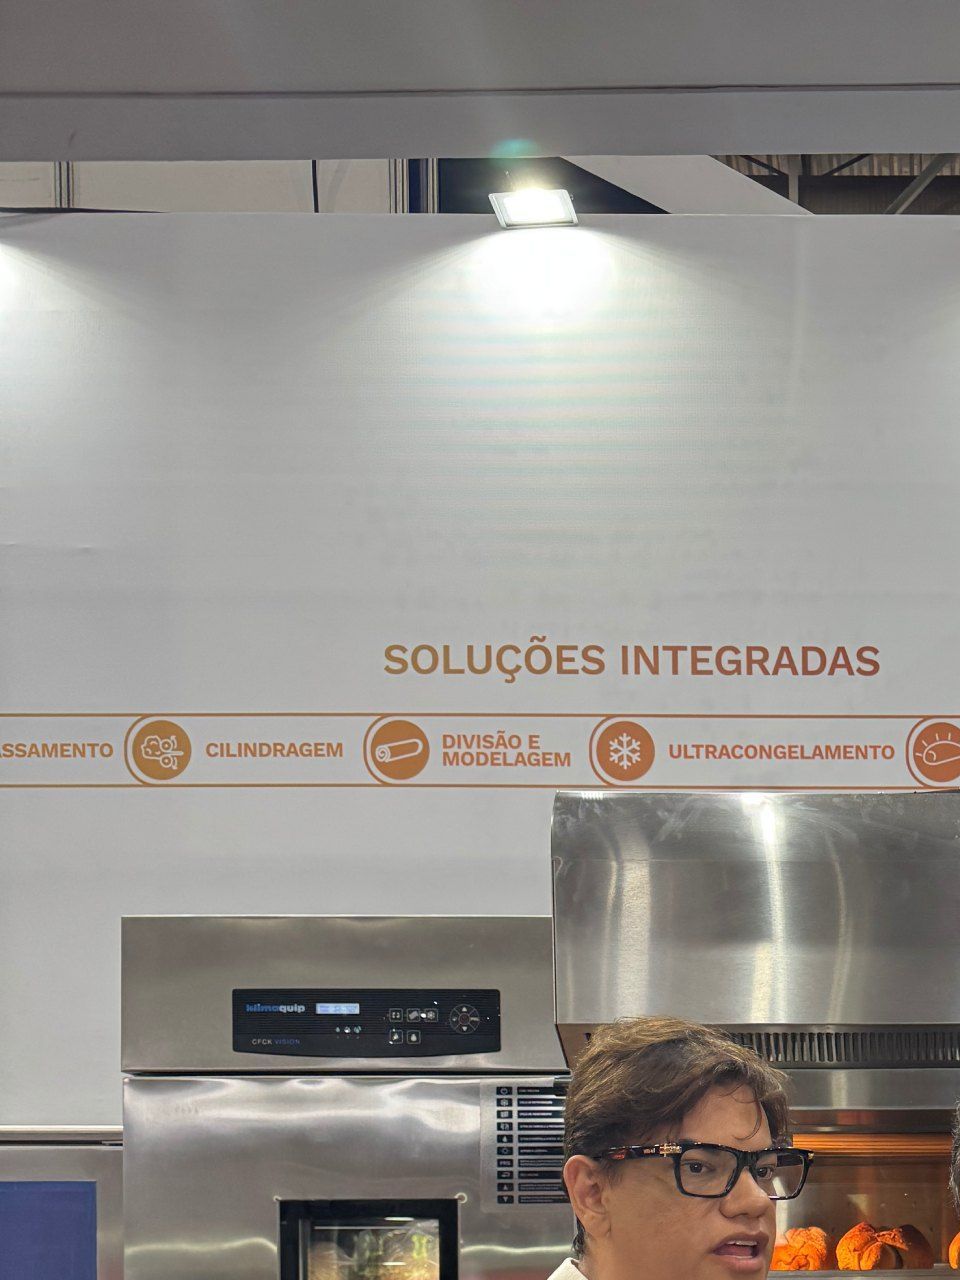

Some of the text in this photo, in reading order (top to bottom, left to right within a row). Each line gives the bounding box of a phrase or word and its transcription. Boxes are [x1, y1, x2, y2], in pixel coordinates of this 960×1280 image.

[384, 635, 880, 684] SOLUÇÕES INTEGRADAS
[442, 730, 541, 749] DIVISÃO E
[0, 743, 114, 758] SSAMENTO
[206, 742, 343, 758] CILINDRAGEM
[669, 744, 895, 760] ULTRACONGELAMENTO
[442, 752, 571, 767] MODELAGEM
